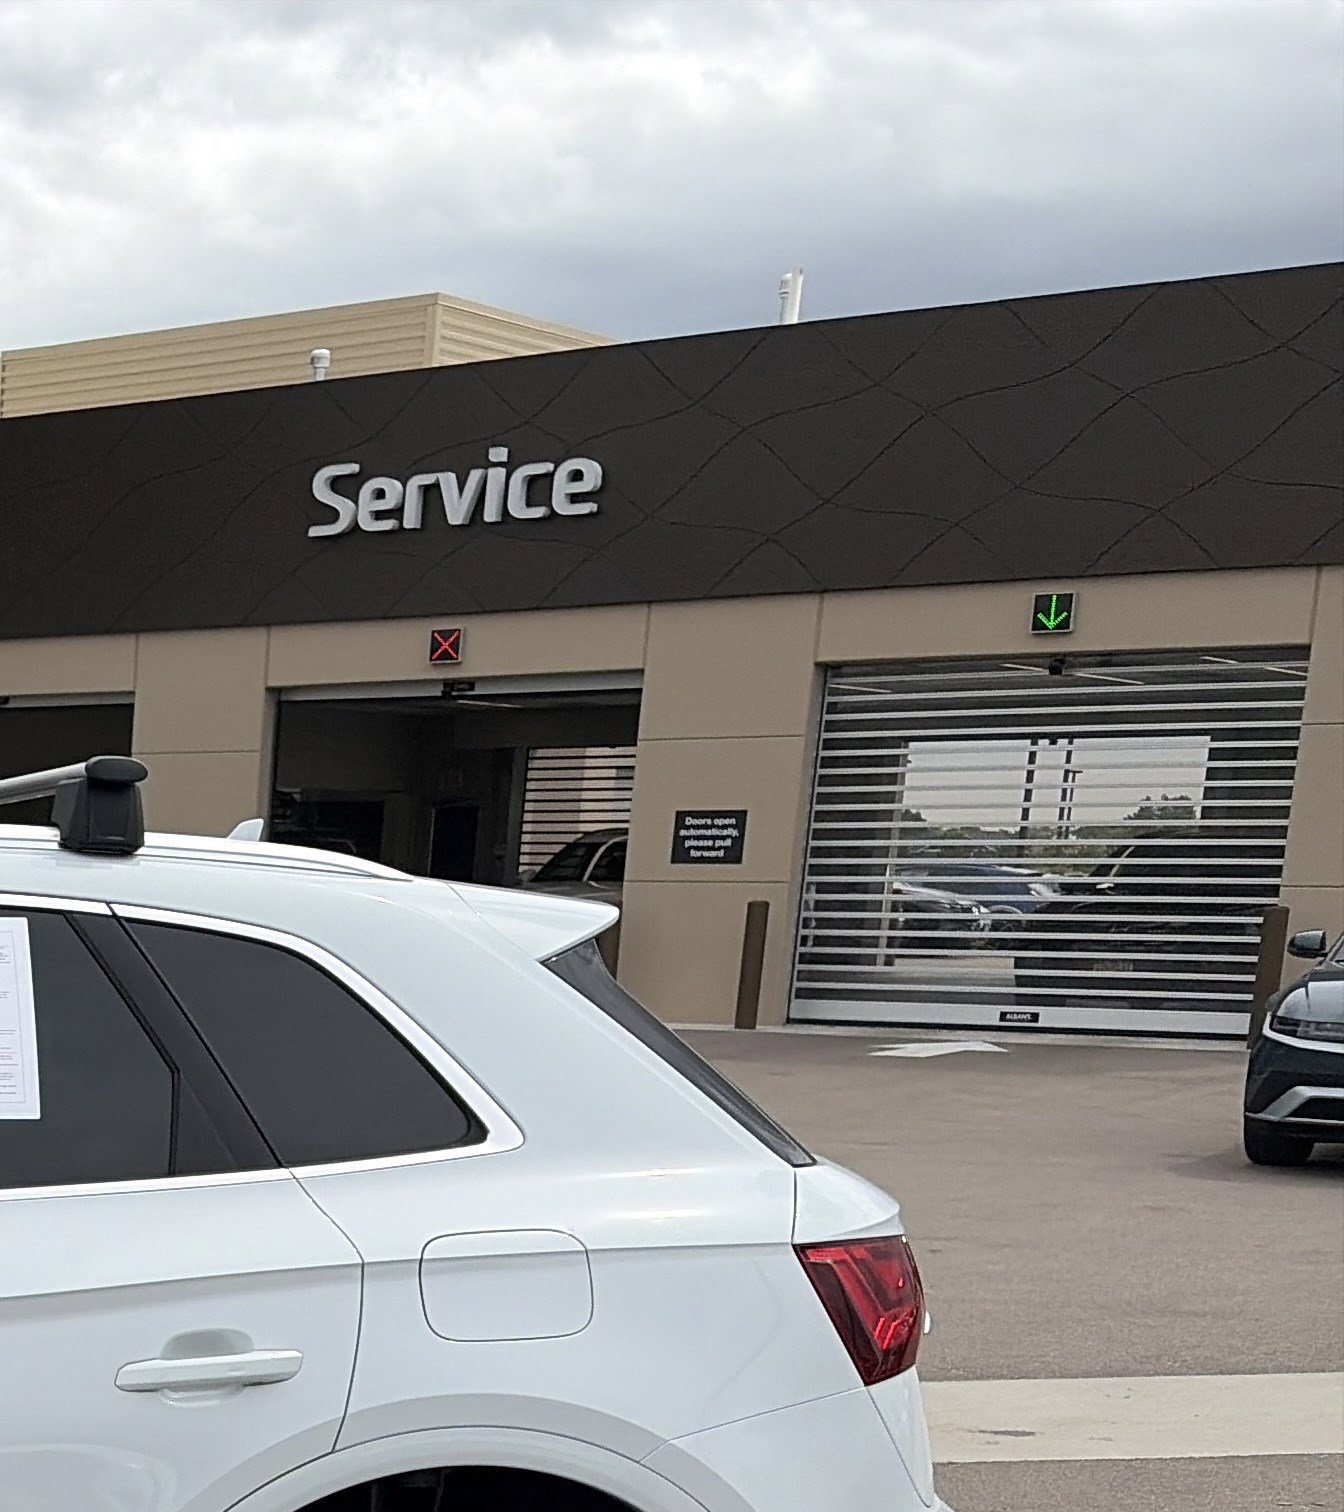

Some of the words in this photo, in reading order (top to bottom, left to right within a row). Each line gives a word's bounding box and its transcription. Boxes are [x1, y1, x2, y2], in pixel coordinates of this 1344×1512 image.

[308, 446, 603, 538] Service
[685, 816, 712, 826] Doors
[713, 817, 736, 826] open
[678, 827, 739, 838] automatically,
[684, 838, 714, 848] please
[715, 838, 732, 848] pull
[690, 849, 725, 858] forward
